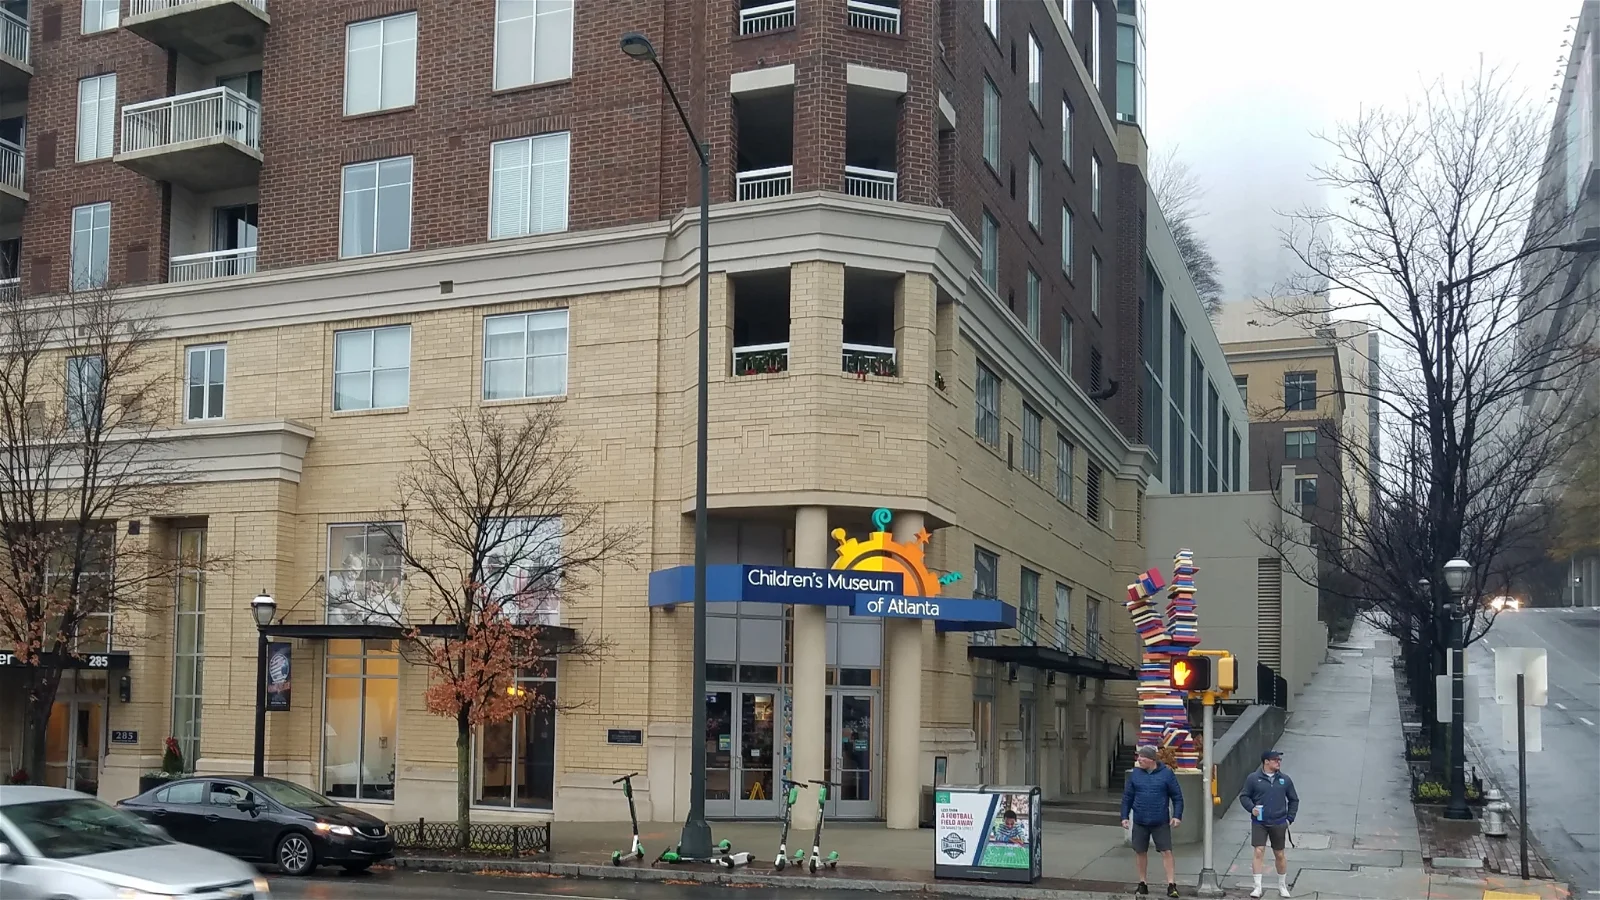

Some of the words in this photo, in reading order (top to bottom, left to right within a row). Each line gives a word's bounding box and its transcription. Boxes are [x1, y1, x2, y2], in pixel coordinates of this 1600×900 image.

[748, 569, 823, 589] Children's
[828, 573, 894, 592] Museum
[867, 597, 884, 613] of
[887, 599, 939, 616] Atlanta
[88, 655, 108, 667] 285
[115, 731, 134, 740] 285
